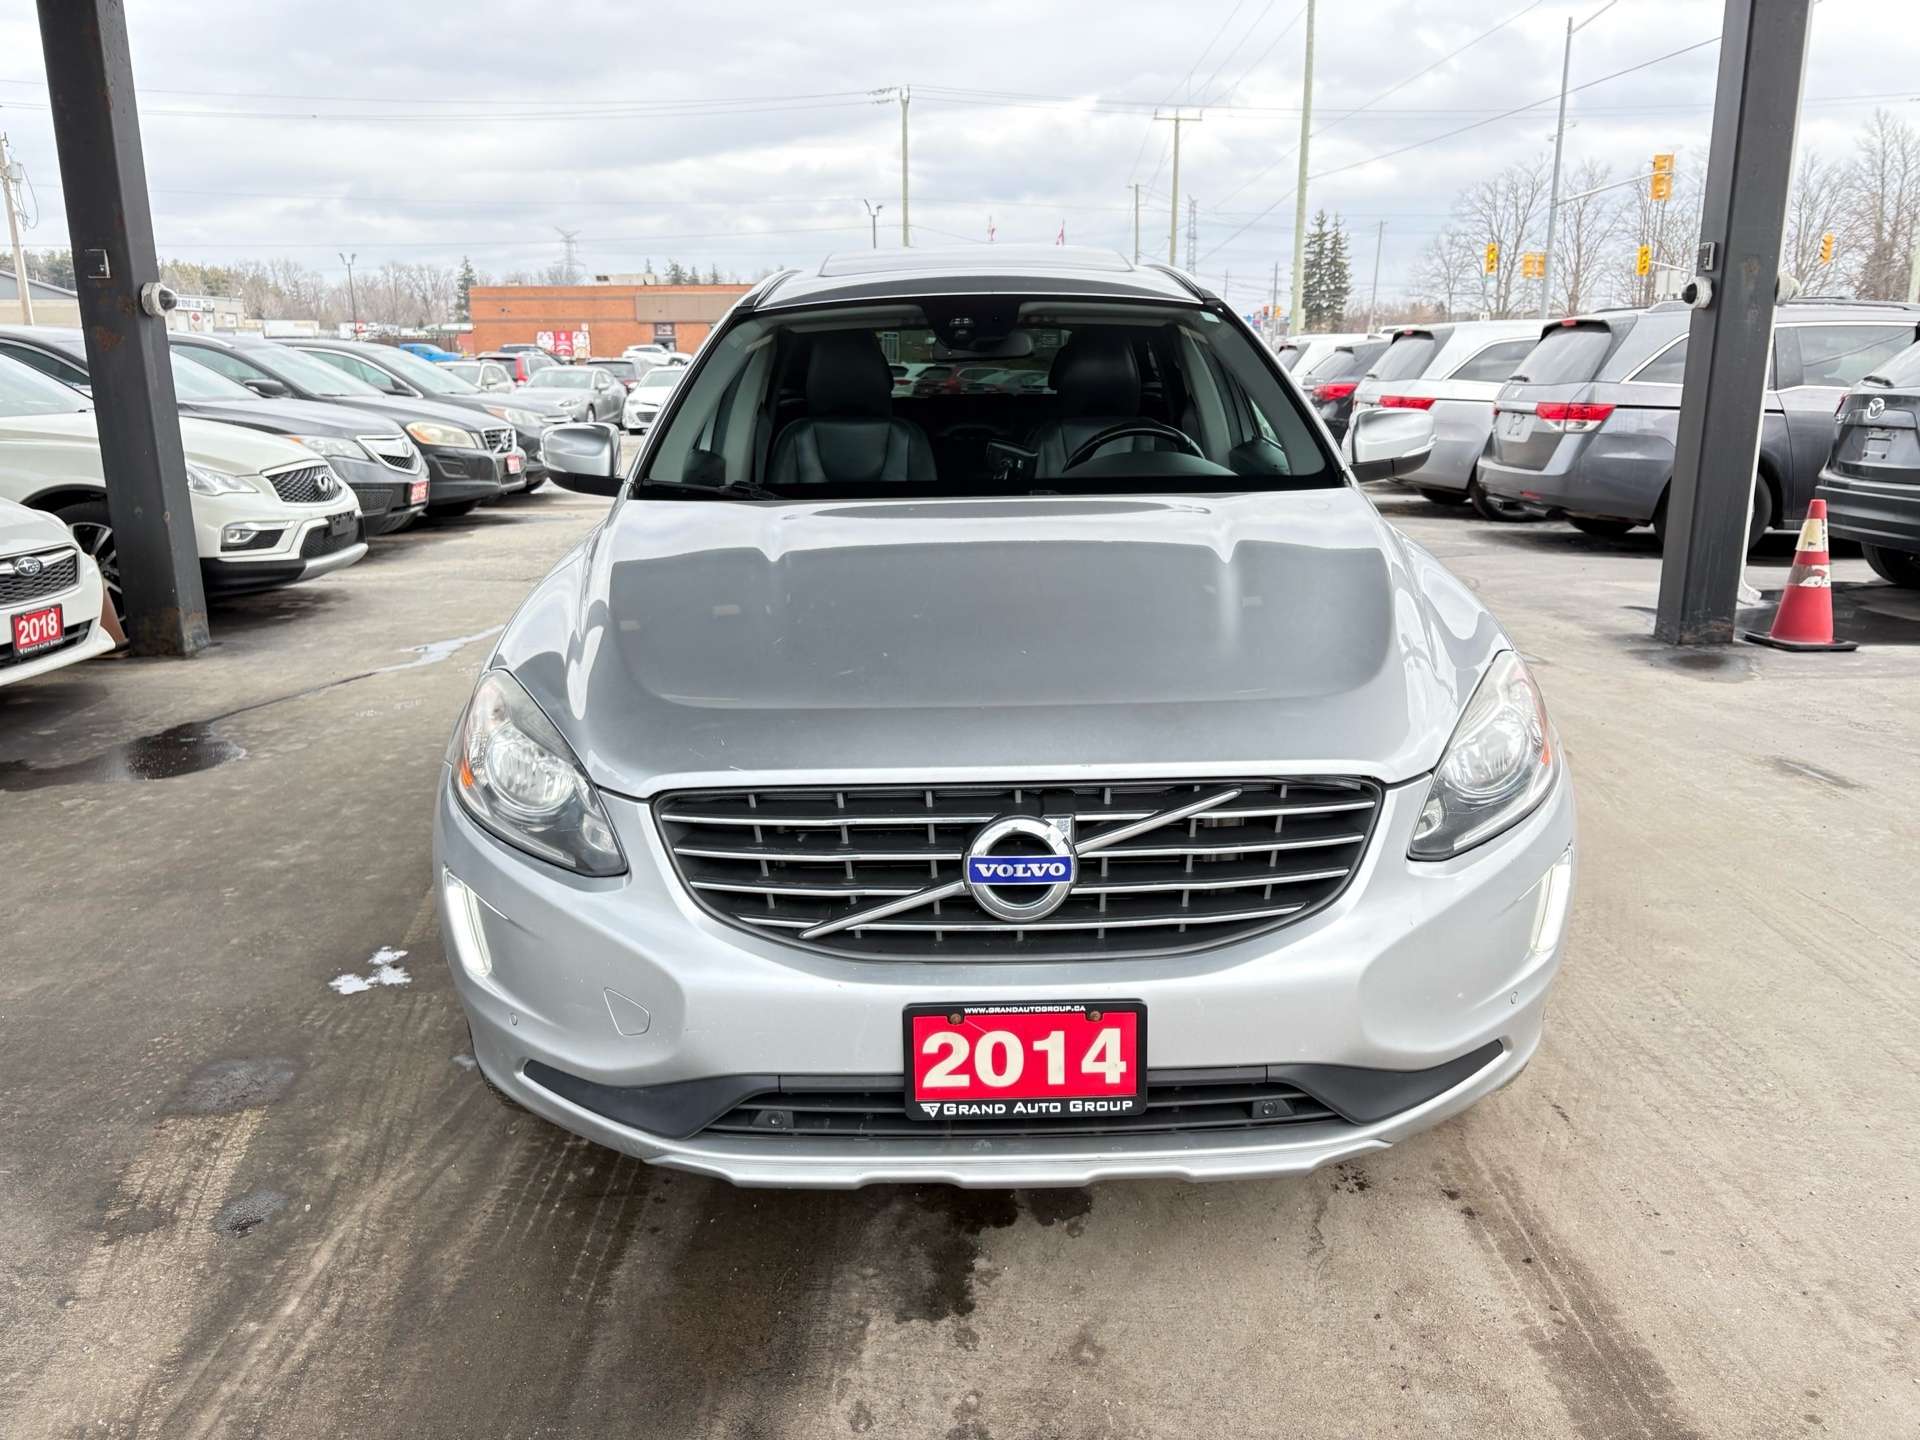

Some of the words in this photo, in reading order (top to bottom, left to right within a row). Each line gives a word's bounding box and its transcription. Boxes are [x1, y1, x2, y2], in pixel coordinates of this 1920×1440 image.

[18, 612, 58, 645] 2018
[974, 862, 1066, 877] VOLVO
[964, 1005, 1086, 1014] WWW.GRANDAUTOGROUP.CA
[922, 1028, 1127, 1088] 2014
[943, 1103, 1006, 1115] GRAND
[1013, 1102, 1061, 1113] AUTO
[1069, 1100, 1133, 1112] GROUP
